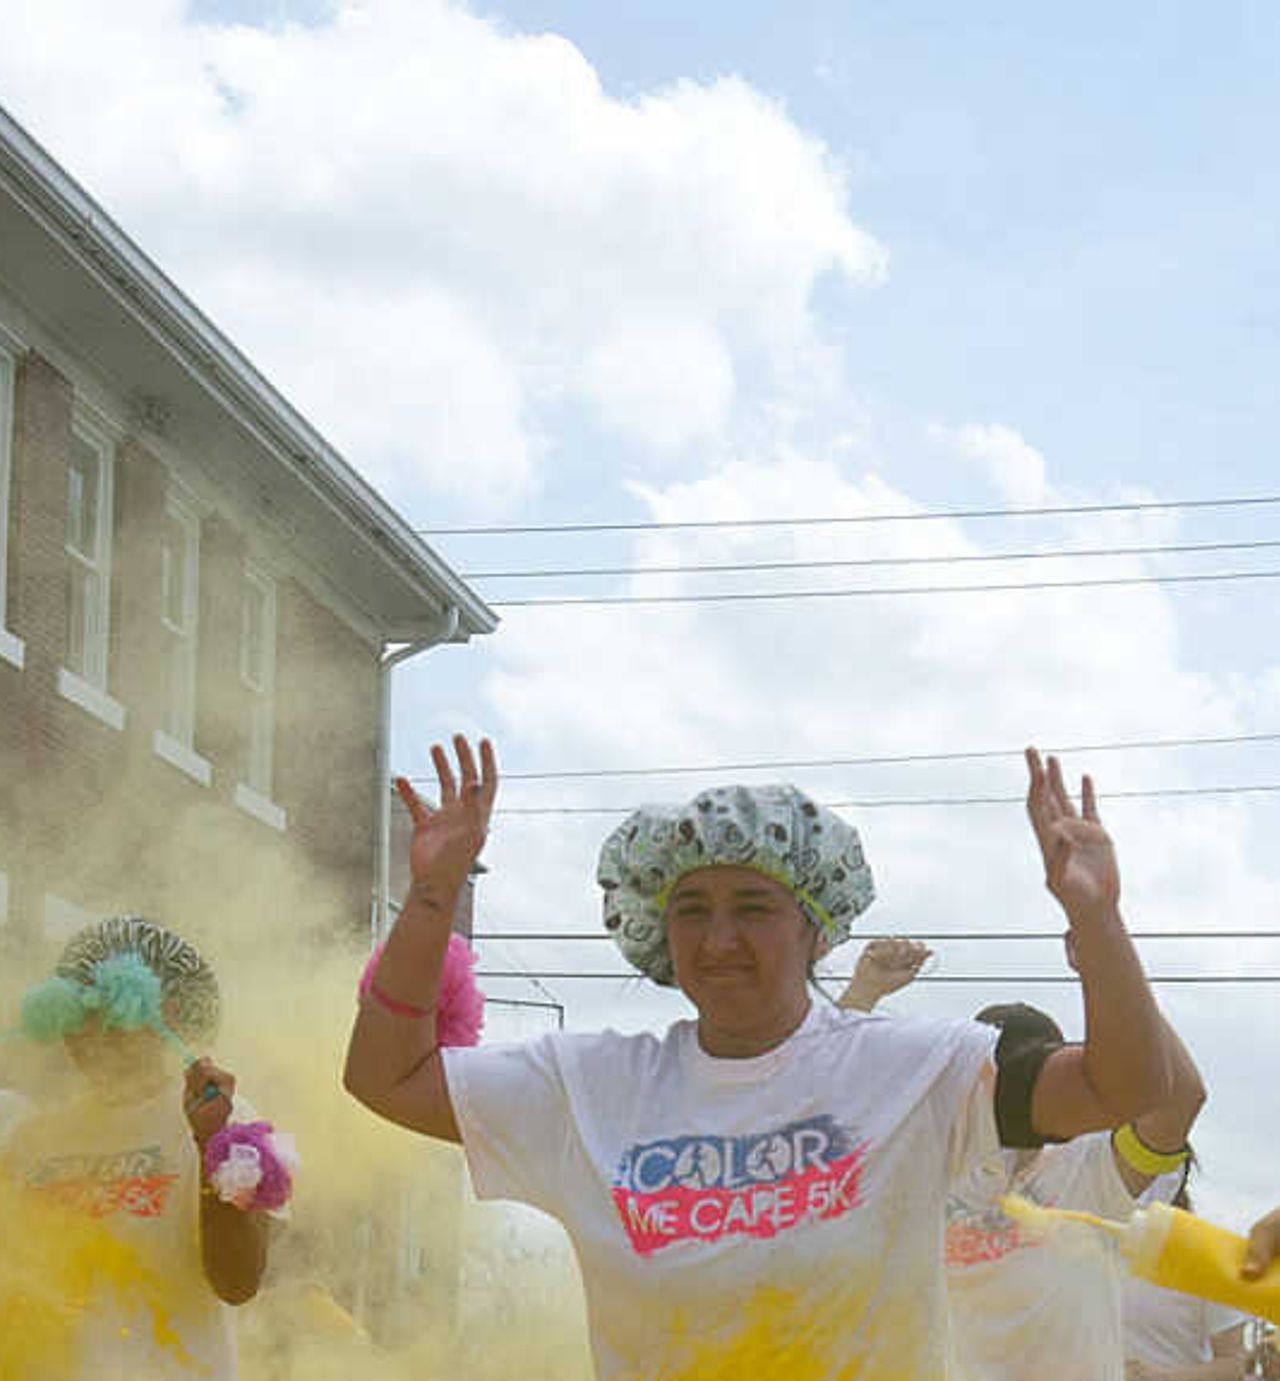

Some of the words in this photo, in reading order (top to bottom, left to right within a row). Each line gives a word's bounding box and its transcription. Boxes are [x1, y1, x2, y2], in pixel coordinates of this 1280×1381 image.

[632, 1129, 832, 1194] COLOR
[625, 1196, 679, 1235] ME
[689, 1186, 795, 1234] CAPE
[808, 1165, 857, 1213] 5K
